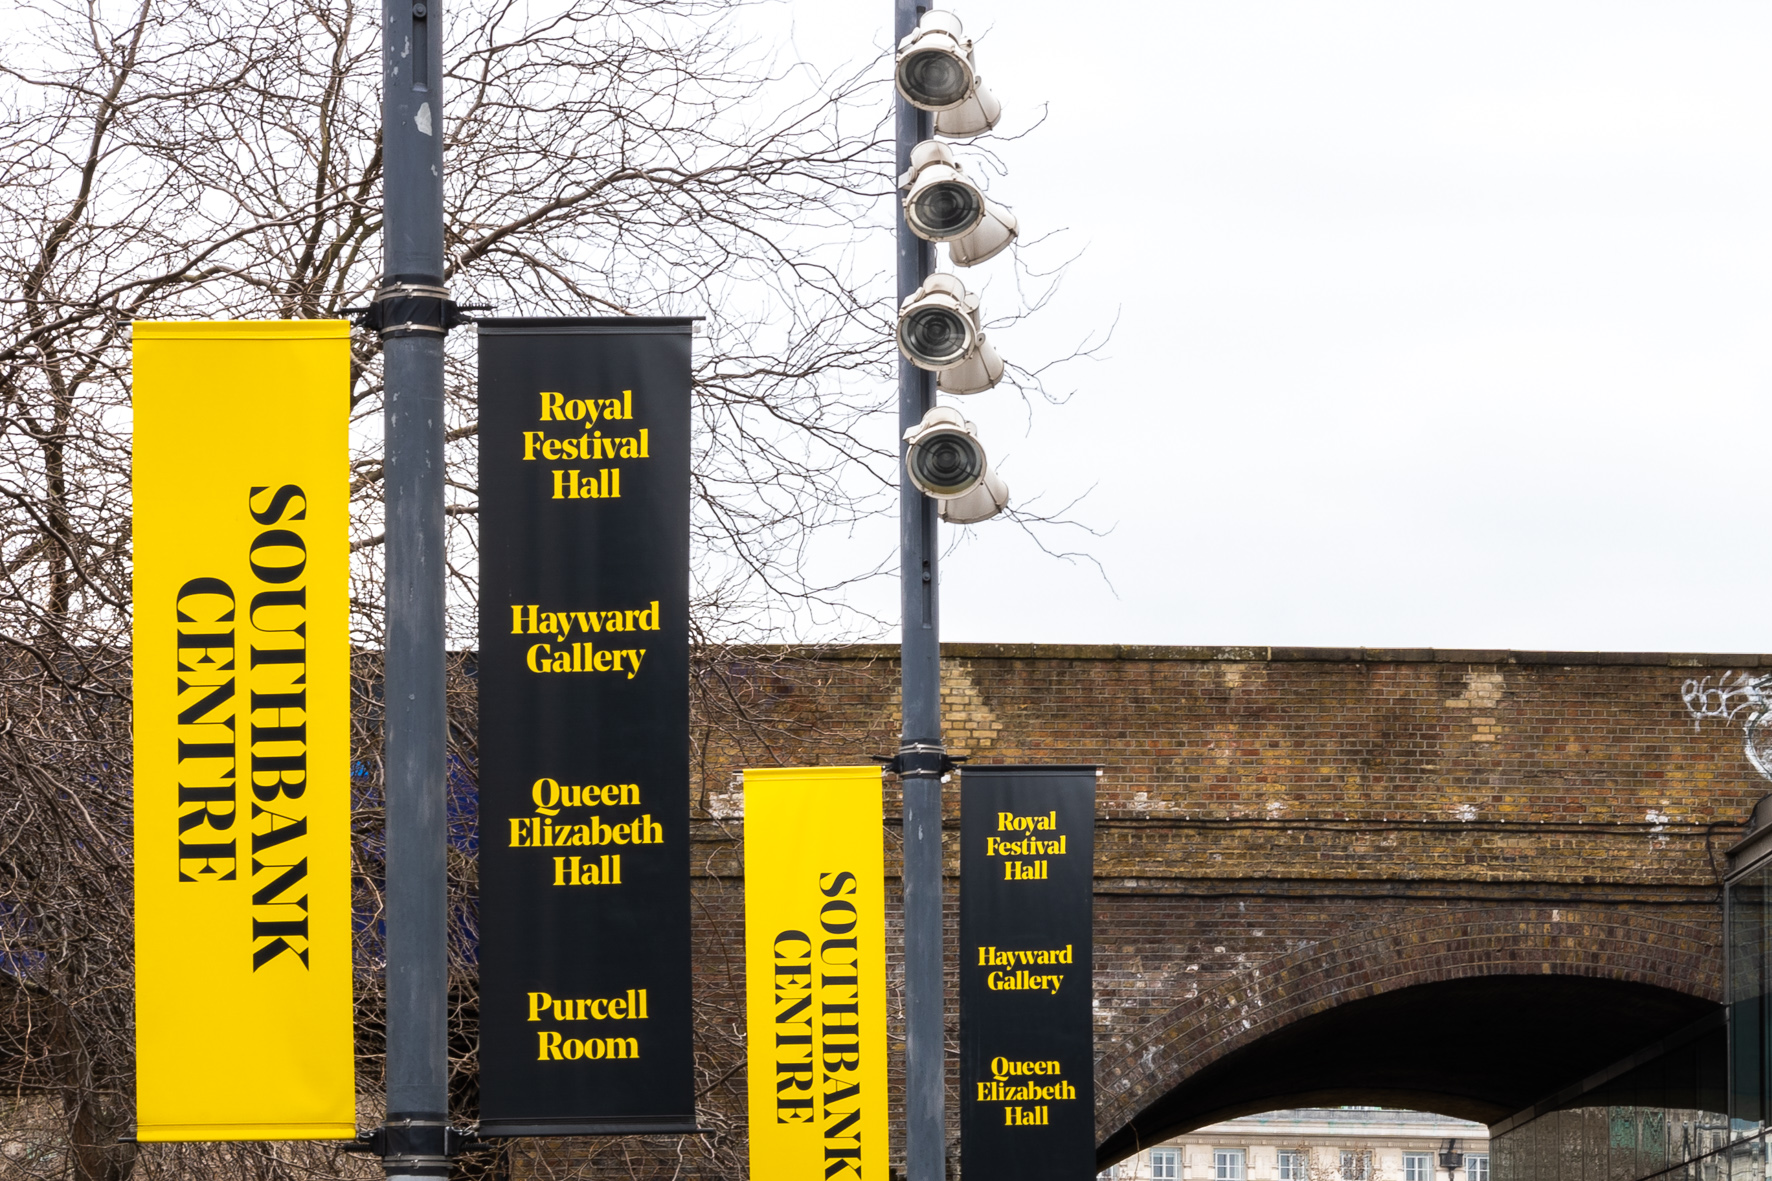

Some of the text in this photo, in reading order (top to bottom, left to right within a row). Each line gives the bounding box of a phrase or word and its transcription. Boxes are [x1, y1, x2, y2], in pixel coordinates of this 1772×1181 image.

[539, 390, 634, 427] Royal
[523, 426, 649, 460] Festival
[552, 468, 621, 499] Hall
[511, 601, 660, 641] Hayward
[527, 640, 646, 678] Gallery
[176, 577, 237, 883] CENTRE
[249, 484, 310, 973] SOUTHBANK
[532, 778, 641, 814] Queen
[509, 814, 664, 848] Elizabeth
[997, 811, 1056, 835] Royal
[986, 835, 1066, 857] Festival
[552, 854, 622, 885] Hall
[1004, 860, 1048, 881] Hall
[978, 944, 1073, 970] Hayward
[988, 970, 1064, 995] Gallery
[528, 989, 648, 1021] Purcell
[774, 929, 814, 1124] CENTRE
[819, 871, 862, 1181] SOUTHBANK
[537, 1032, 639, 1061] Room
[990, 1057, 1061, 1080] Queen
[977, 1081, 1077, 1102] Elizabeth
[1005, 1105, 1049, 1126] Hall
